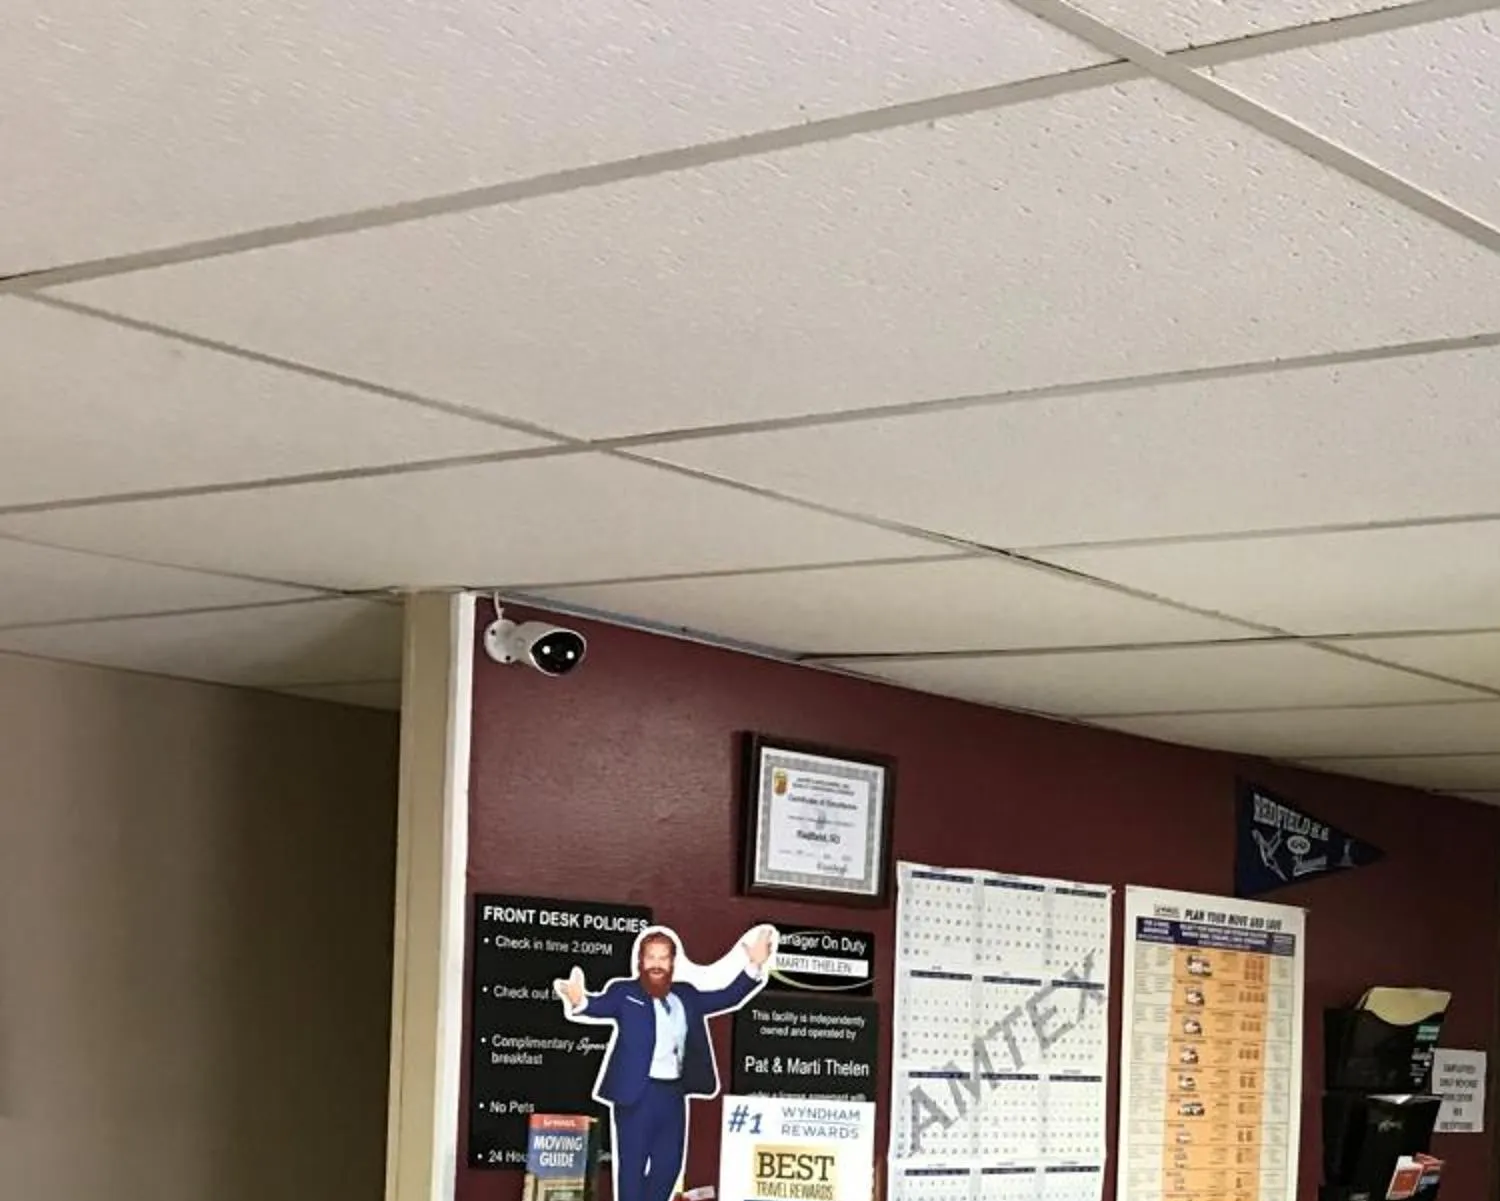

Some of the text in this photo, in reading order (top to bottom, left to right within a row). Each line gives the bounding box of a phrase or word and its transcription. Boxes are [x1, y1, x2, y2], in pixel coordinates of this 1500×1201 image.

[483, 905, 648, 933] FRONT DESK POLICIES
[1185, 908, 1205, 921] PLAN
[495, 935, 532, 951] Check
[533, 939, 543, 951] in
[545, 939, 569, 953] time
[777, 933, 867, 956] anager On Duty
[776, 955, 852, 973] MARTI THELEN
[493, 984, 529, 999] Check
[531, 988, 549, 1001] out
[752, 1009, 770, 1021] This
[771, 1010, 799, 1025] facility
[809, 1013, 865, 1029] independently
[759, 1026, 857, 1041] owned and operated by
[491, 1034, 574, 1052] Complimentary
[491, 1052, 543, 1065] breakfast
[908, 947, 1106, 1158] AMTEX
[744, 1055, 869, 1077] Pat & Marti Thelen
[489, 1101, 535, 1114] No Pets
[781, 1106, 861, 1121] WYNDHAM
[728, 1104, 763, 1135] #1
[781, 1124, 860, 1139] REWARDS
[533, 1135, 583, 1151] MOVING
[488, 1149, 503, 1163] 24
[539, 1151, 574, 1169] GUIDE
[756, 1152, 835, 1182] BEST
[756, 1181, 833, 1201] TRAVEL REWARDS
